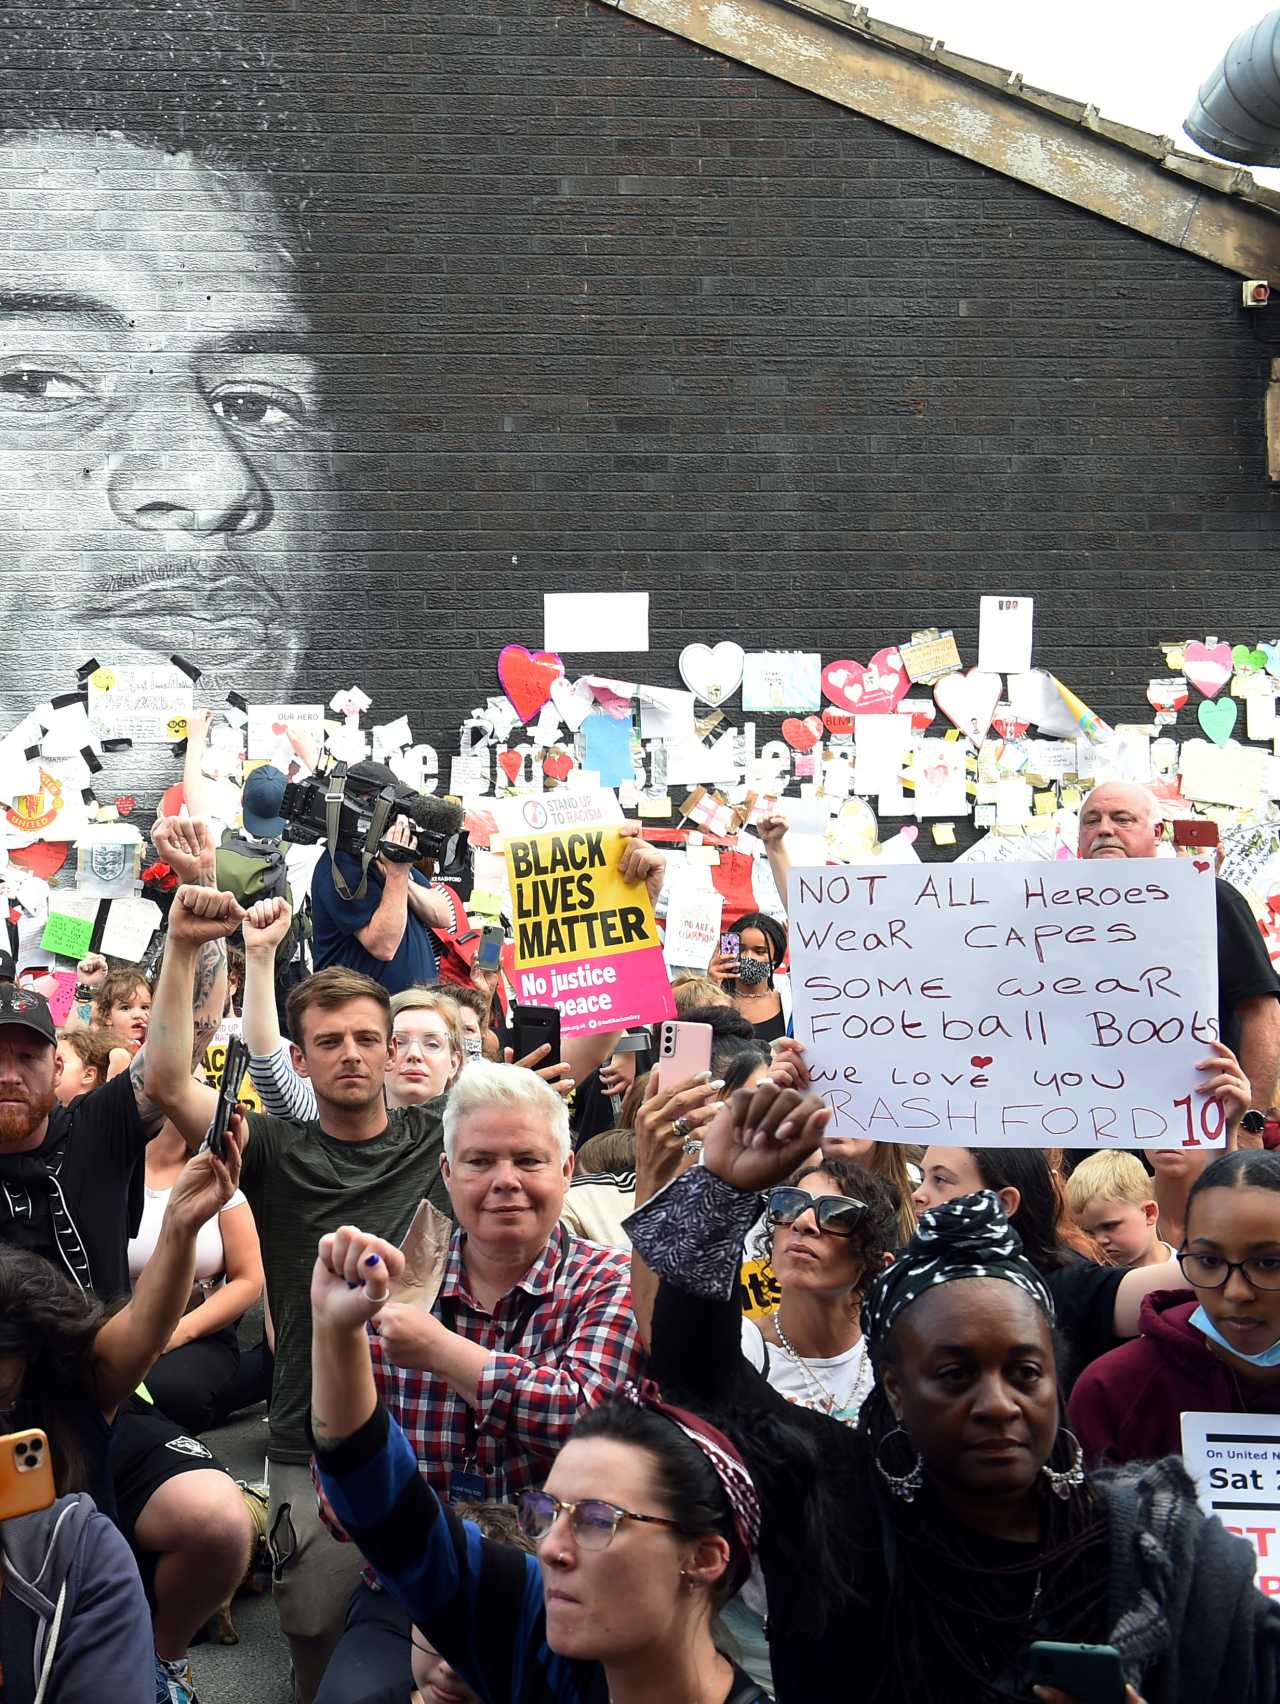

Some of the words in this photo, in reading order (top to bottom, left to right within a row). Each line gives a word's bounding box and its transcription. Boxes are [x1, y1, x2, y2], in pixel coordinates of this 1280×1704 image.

[277, 713, 295, 721] OUR
[297, 713, 320, 721] HERO
[547, 798, 578, 812] STAND
[578, 795, 593, 808] UP
[552, 814, 566, 826] TO
[566, 808, 602, 824] RACISM
[11, 815, 49, 828] UNITED
[510, 831, 607, 879] BLACK
[517, 873, 595, 920] LIVES
[799, 875, 888, 906] NOT
[914, 874, 991, 909] ALL
[518, 906, 650, 961] MATTER
[521, 971, 547, 998] No
[550, 963, 617, 999] justice
[803, 976, 953, 1001] SOME
[559, 992, 613, 1020] peace
[810, 1009, 1048, 1046] Football
[1172, 1093, 1226, 1147] 10
[1206, 1449, 1223, 1460] On
[1226, 1449, 1268, 1461] United
[1209, 1467, 1265, 1491] Sat
